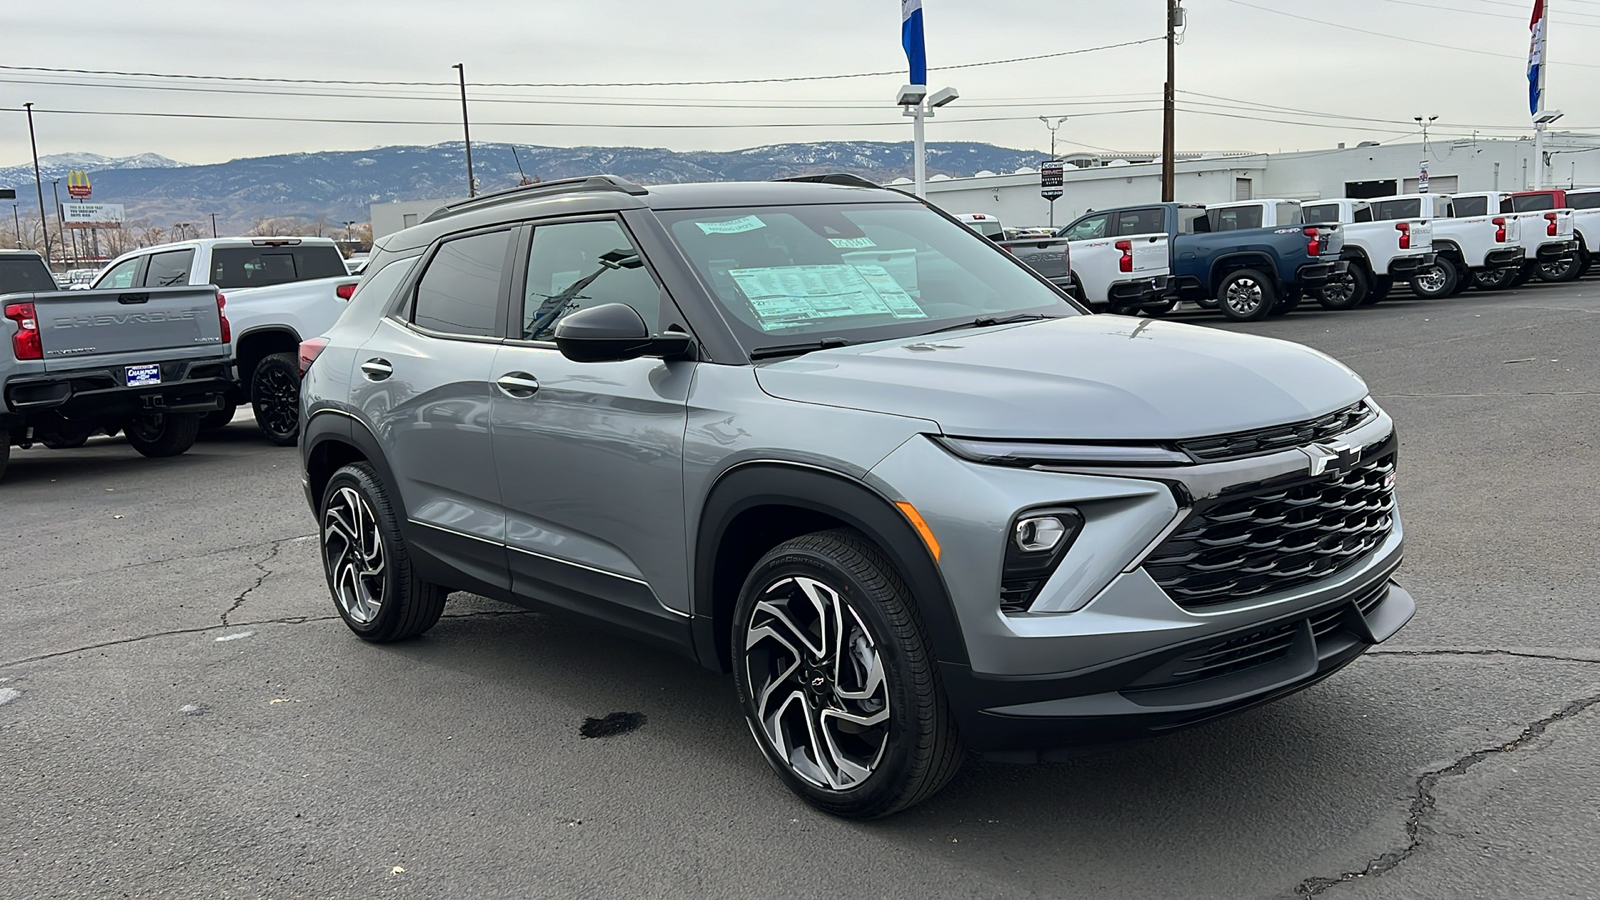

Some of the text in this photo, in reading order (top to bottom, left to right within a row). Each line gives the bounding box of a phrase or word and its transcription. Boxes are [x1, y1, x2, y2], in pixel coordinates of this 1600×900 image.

[53, 310, 209, 329] CHEVROLET
[46, 346, 97, 356] SILVERADO
[128, 368, 158, 377] CHAMPION
